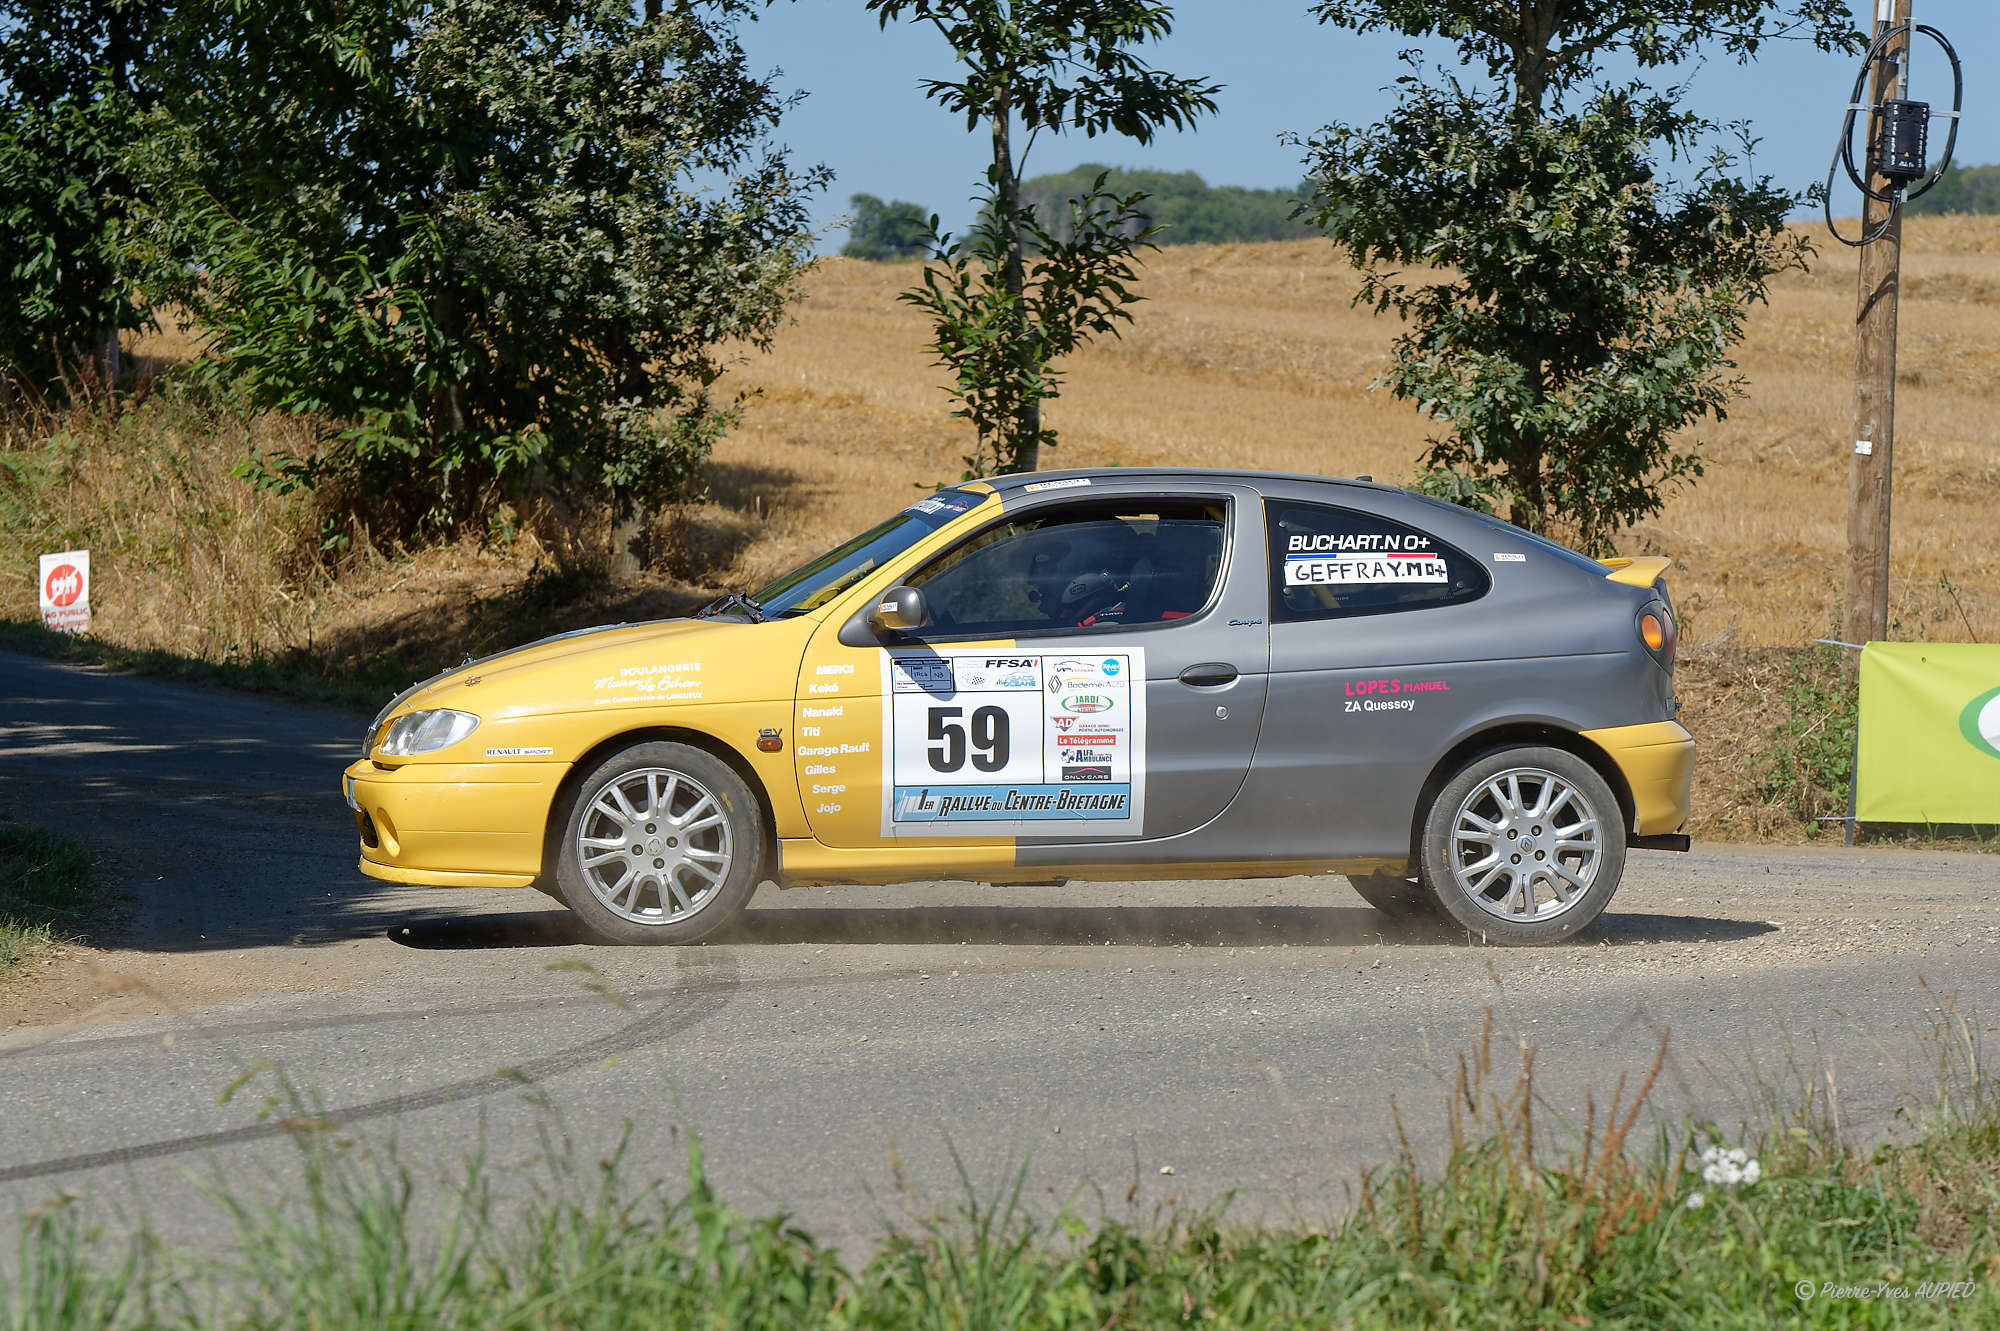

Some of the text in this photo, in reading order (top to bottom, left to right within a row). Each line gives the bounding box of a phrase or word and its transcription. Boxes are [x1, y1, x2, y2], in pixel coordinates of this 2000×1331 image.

[1288, 535, 1399, 551] BUCHART.N
[816, 664, 854, 675] MERCI
[985, 659, 1032, 668] FFSA
[620, 663, 702, 677] BOULANGERIE
[1345, 678, 1401, 697] LOPES
[1344, 699, 1415, 712] ZA Quessoy
[1058, 718, 1074, 728] AD
[927, 705, 1010, 773] 59
[1070, 736, 1114, 745] Télégramme
[797, 745, 839, 757] Garage
[804, 764, 837, 775] Gilles
[812, 784, 846, 795] Serge
[816, 802, 841, 814] Jojo
[938, 796, 991, 817] RALLYE
[1004, 789, 1127, 811] CENTRE-BRETAGNE
